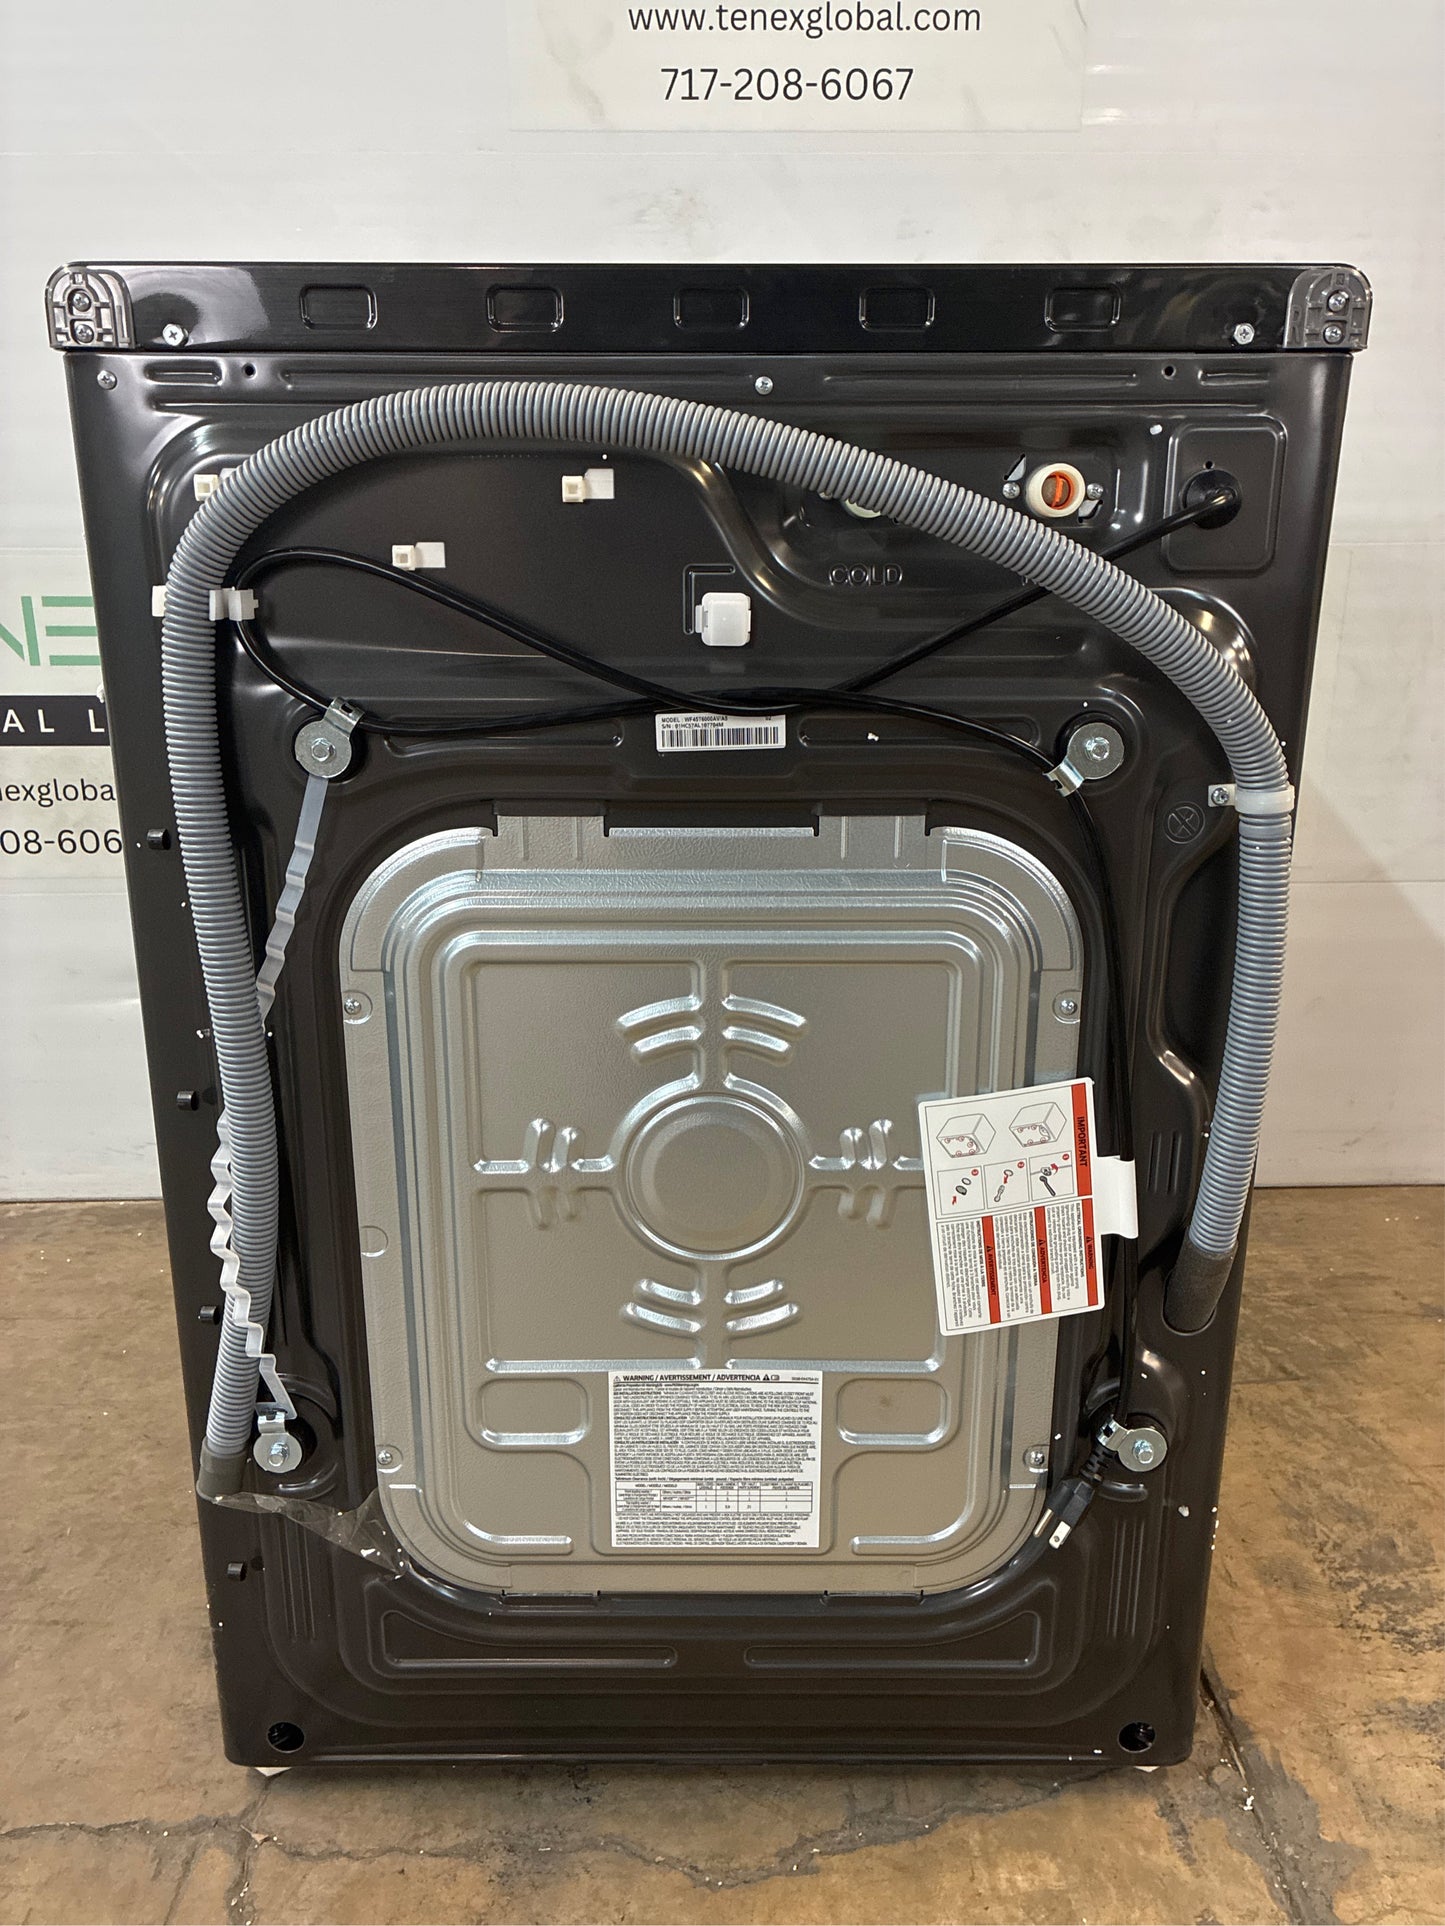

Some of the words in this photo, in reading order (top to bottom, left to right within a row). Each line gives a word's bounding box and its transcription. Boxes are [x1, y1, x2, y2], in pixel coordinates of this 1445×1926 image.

[628, 2, 981, 38] www.tenexglobal.com
[660, 68, 914, 101] 717-208-6067
[829, 563, 903, 586] COLD
[0, 778, 117, 807] exgloba
[1077, 1116, 1088, 1167] IMPORTANT
[987, 1253, 995, 1296] AVERTISSEMENT
